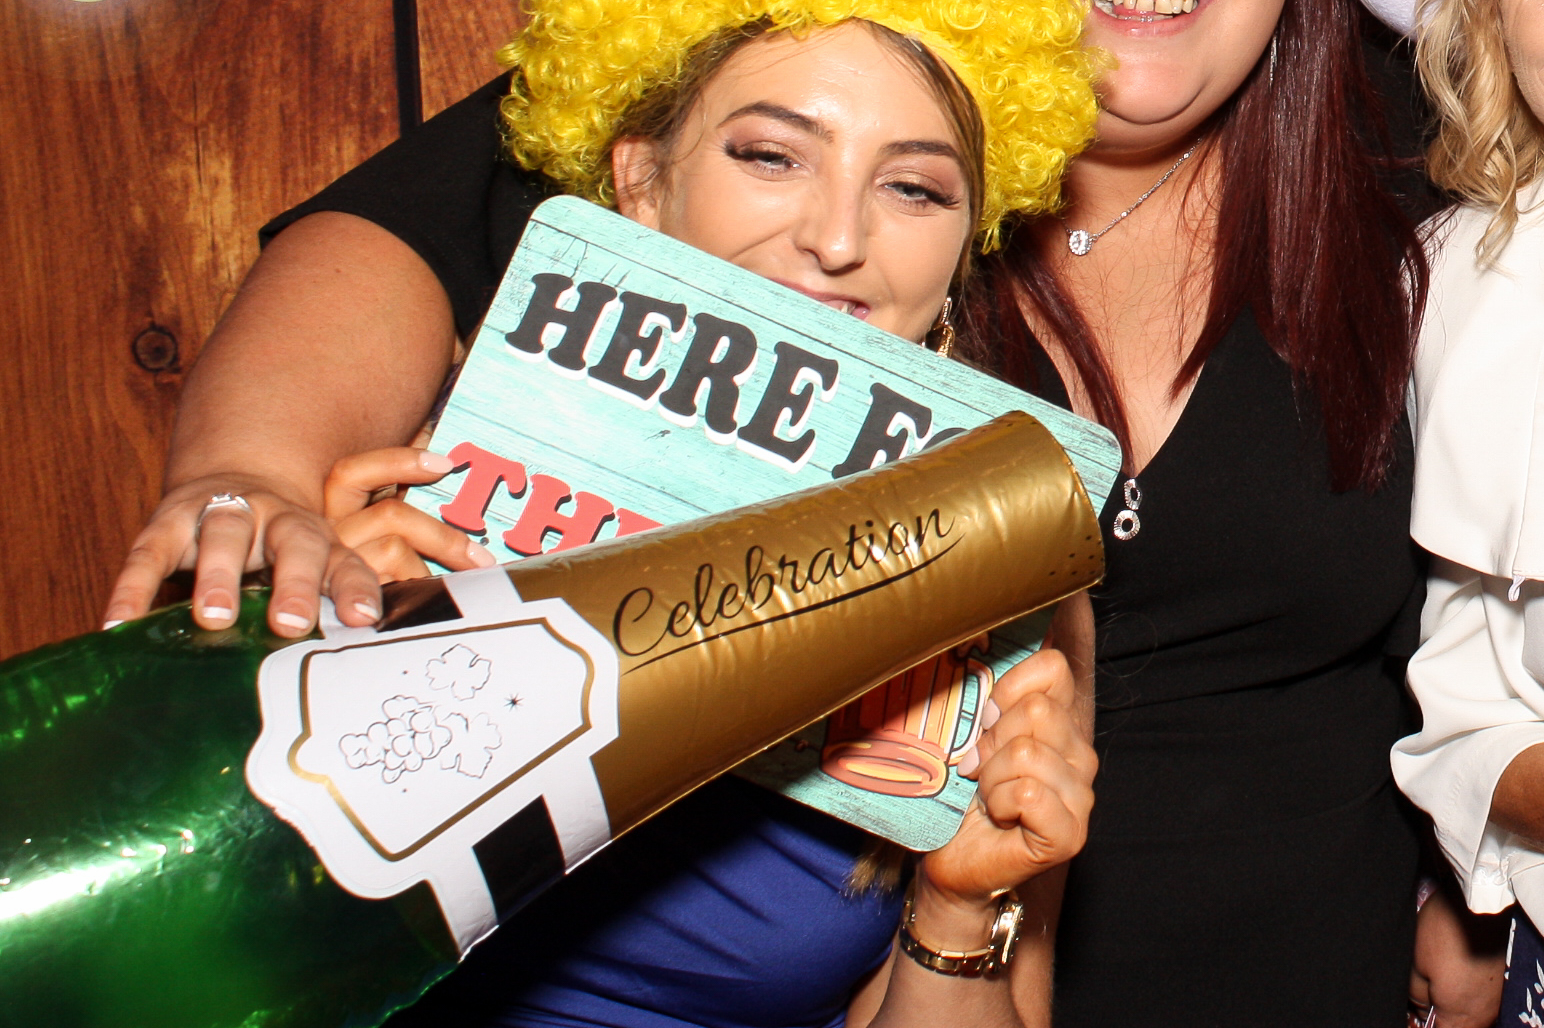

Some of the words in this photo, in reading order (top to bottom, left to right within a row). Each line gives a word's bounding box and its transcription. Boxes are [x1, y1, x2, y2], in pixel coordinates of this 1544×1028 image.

[504, 272, 839, 472] HERE
[439, 441, 664, 557] TH
[612, 505, 955, 657] Celebration
